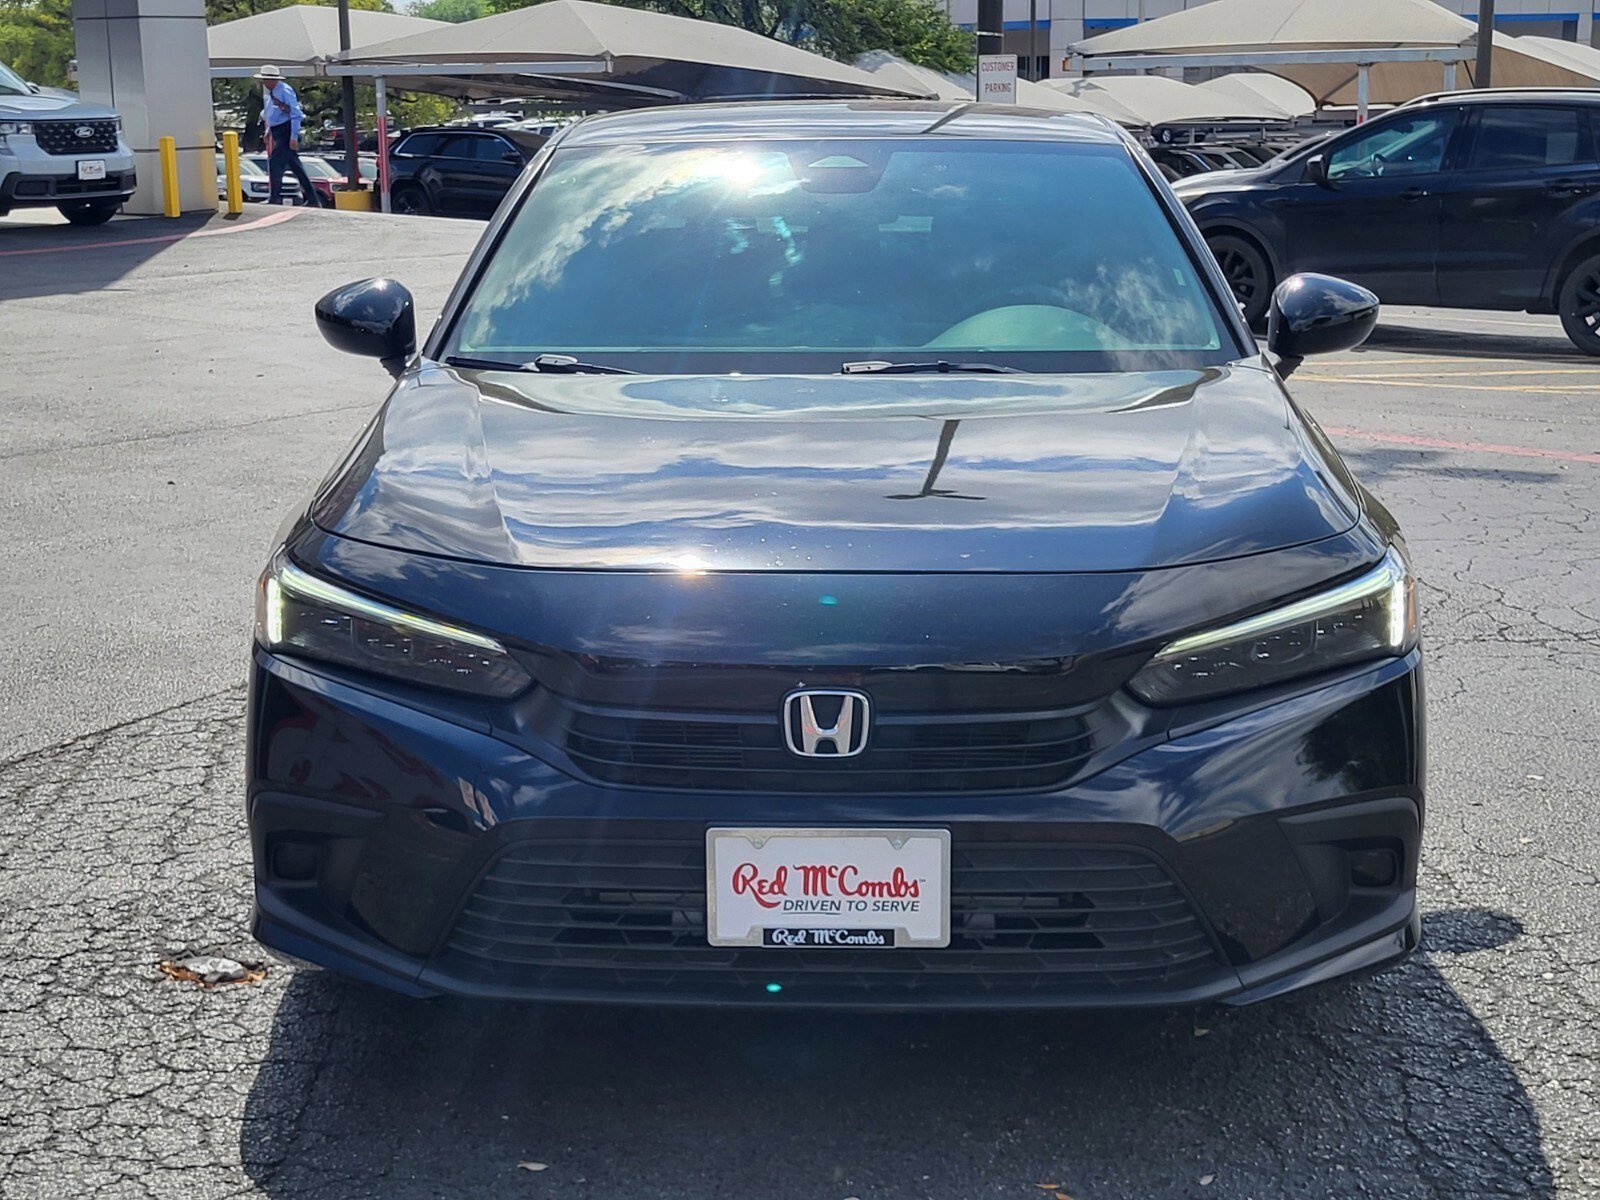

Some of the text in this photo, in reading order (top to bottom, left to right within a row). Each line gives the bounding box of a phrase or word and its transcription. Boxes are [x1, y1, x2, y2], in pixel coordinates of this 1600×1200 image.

[981, 61, 1015, 72] CUSTOMER
[984, 82, 1012, 93] PARKING
[732, 862, 920, 909] Red McCombs
[783, 899, 920, 912] DRIVEN TO SERVE
[771, 928, 885, 946] Red McCombs
